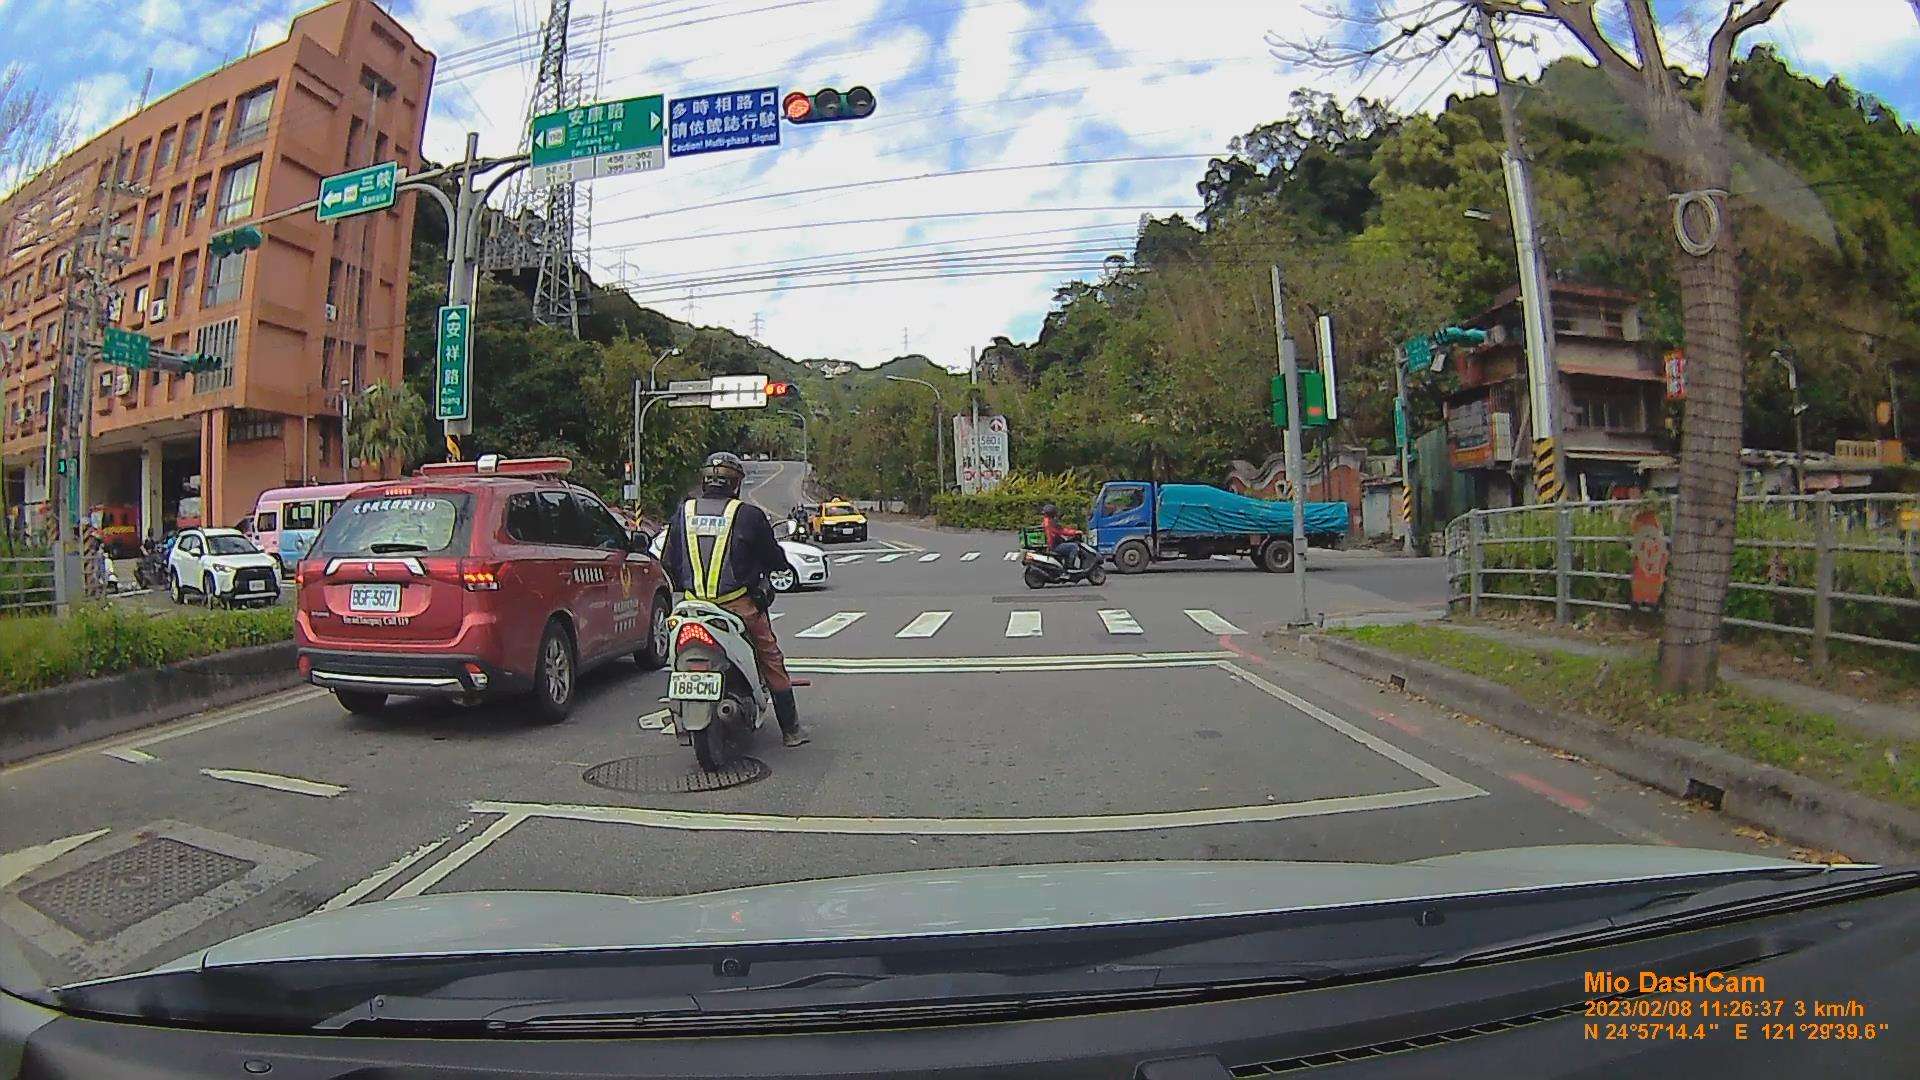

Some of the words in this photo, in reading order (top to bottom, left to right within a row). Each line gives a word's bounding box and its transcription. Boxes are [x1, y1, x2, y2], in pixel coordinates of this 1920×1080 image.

[568, 103, 624, 126] 安康路
[672, 92, 775, 120] 多時相路口
[672, 111, 776, 139] 請依號誌行駛
[752, 132, 777, 144] Signal
[444, 321, 461, 385] 安祥路
[382, 617, 397, 626] Call
